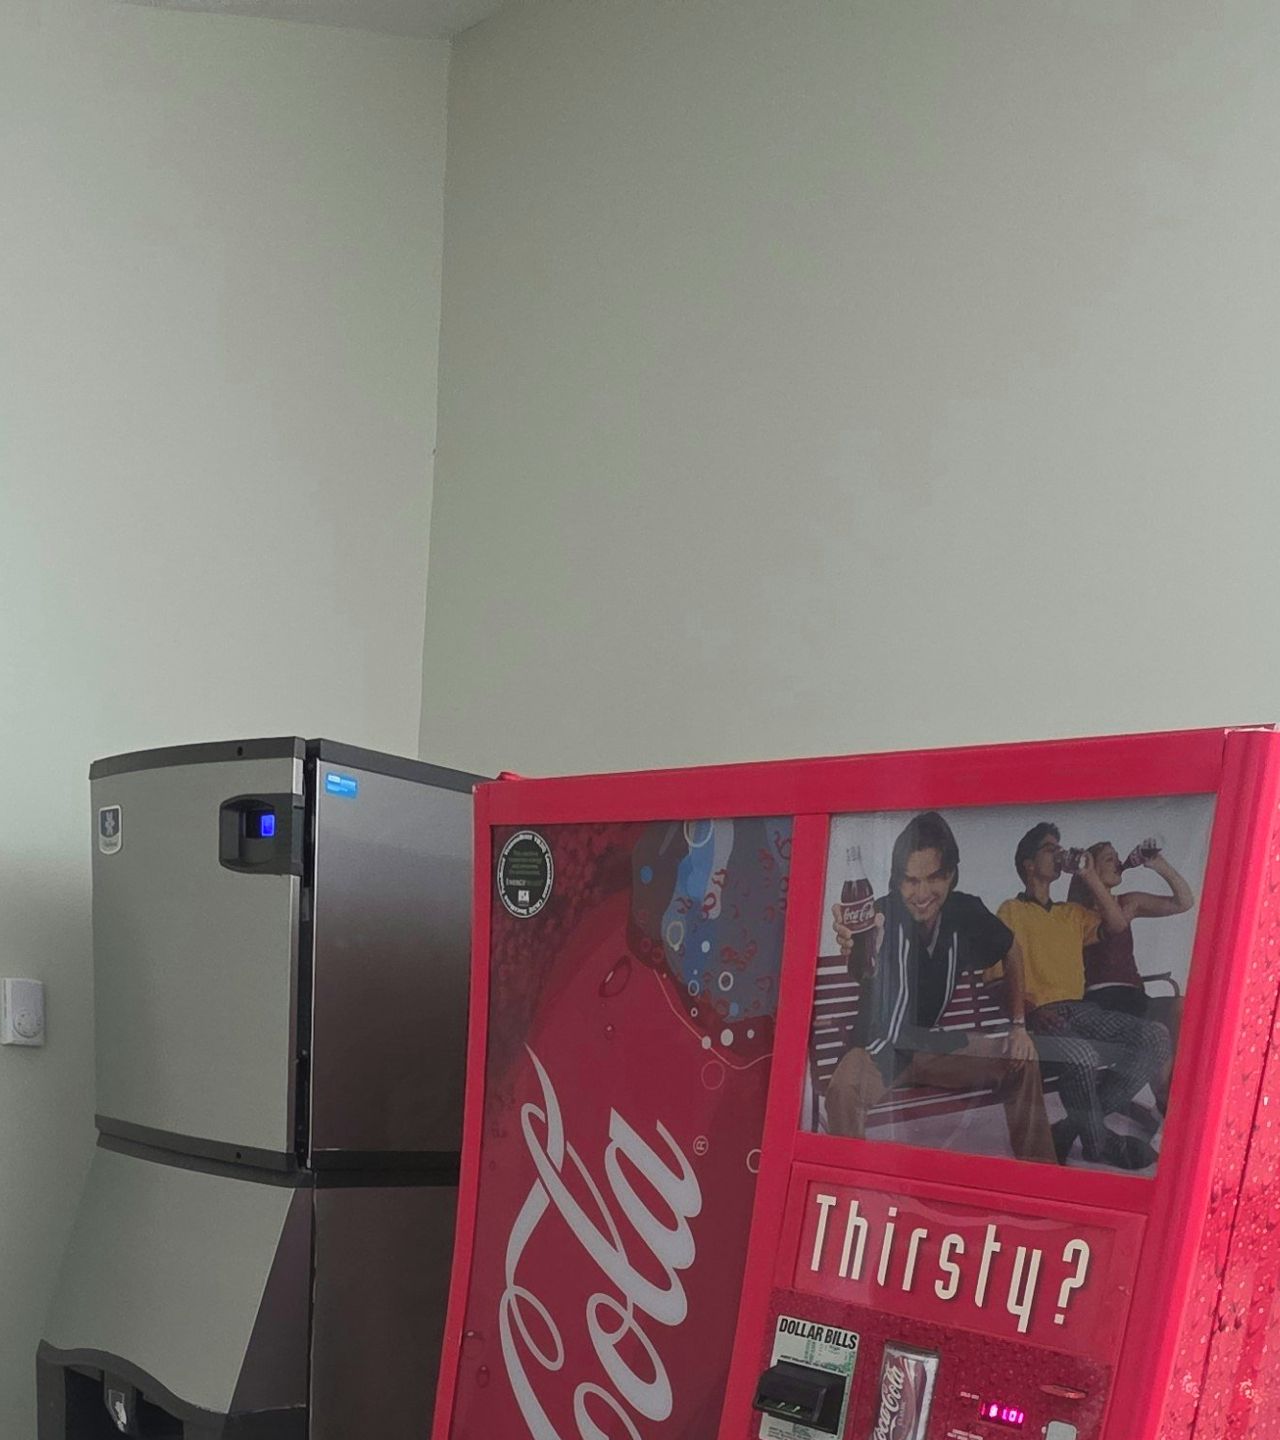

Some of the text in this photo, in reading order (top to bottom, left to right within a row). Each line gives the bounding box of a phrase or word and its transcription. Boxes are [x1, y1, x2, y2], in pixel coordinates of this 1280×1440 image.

[810, 1193, 1091, 1334] Thirsty?
[778, 1317, 858, 1350] DOLLAR BILLS
